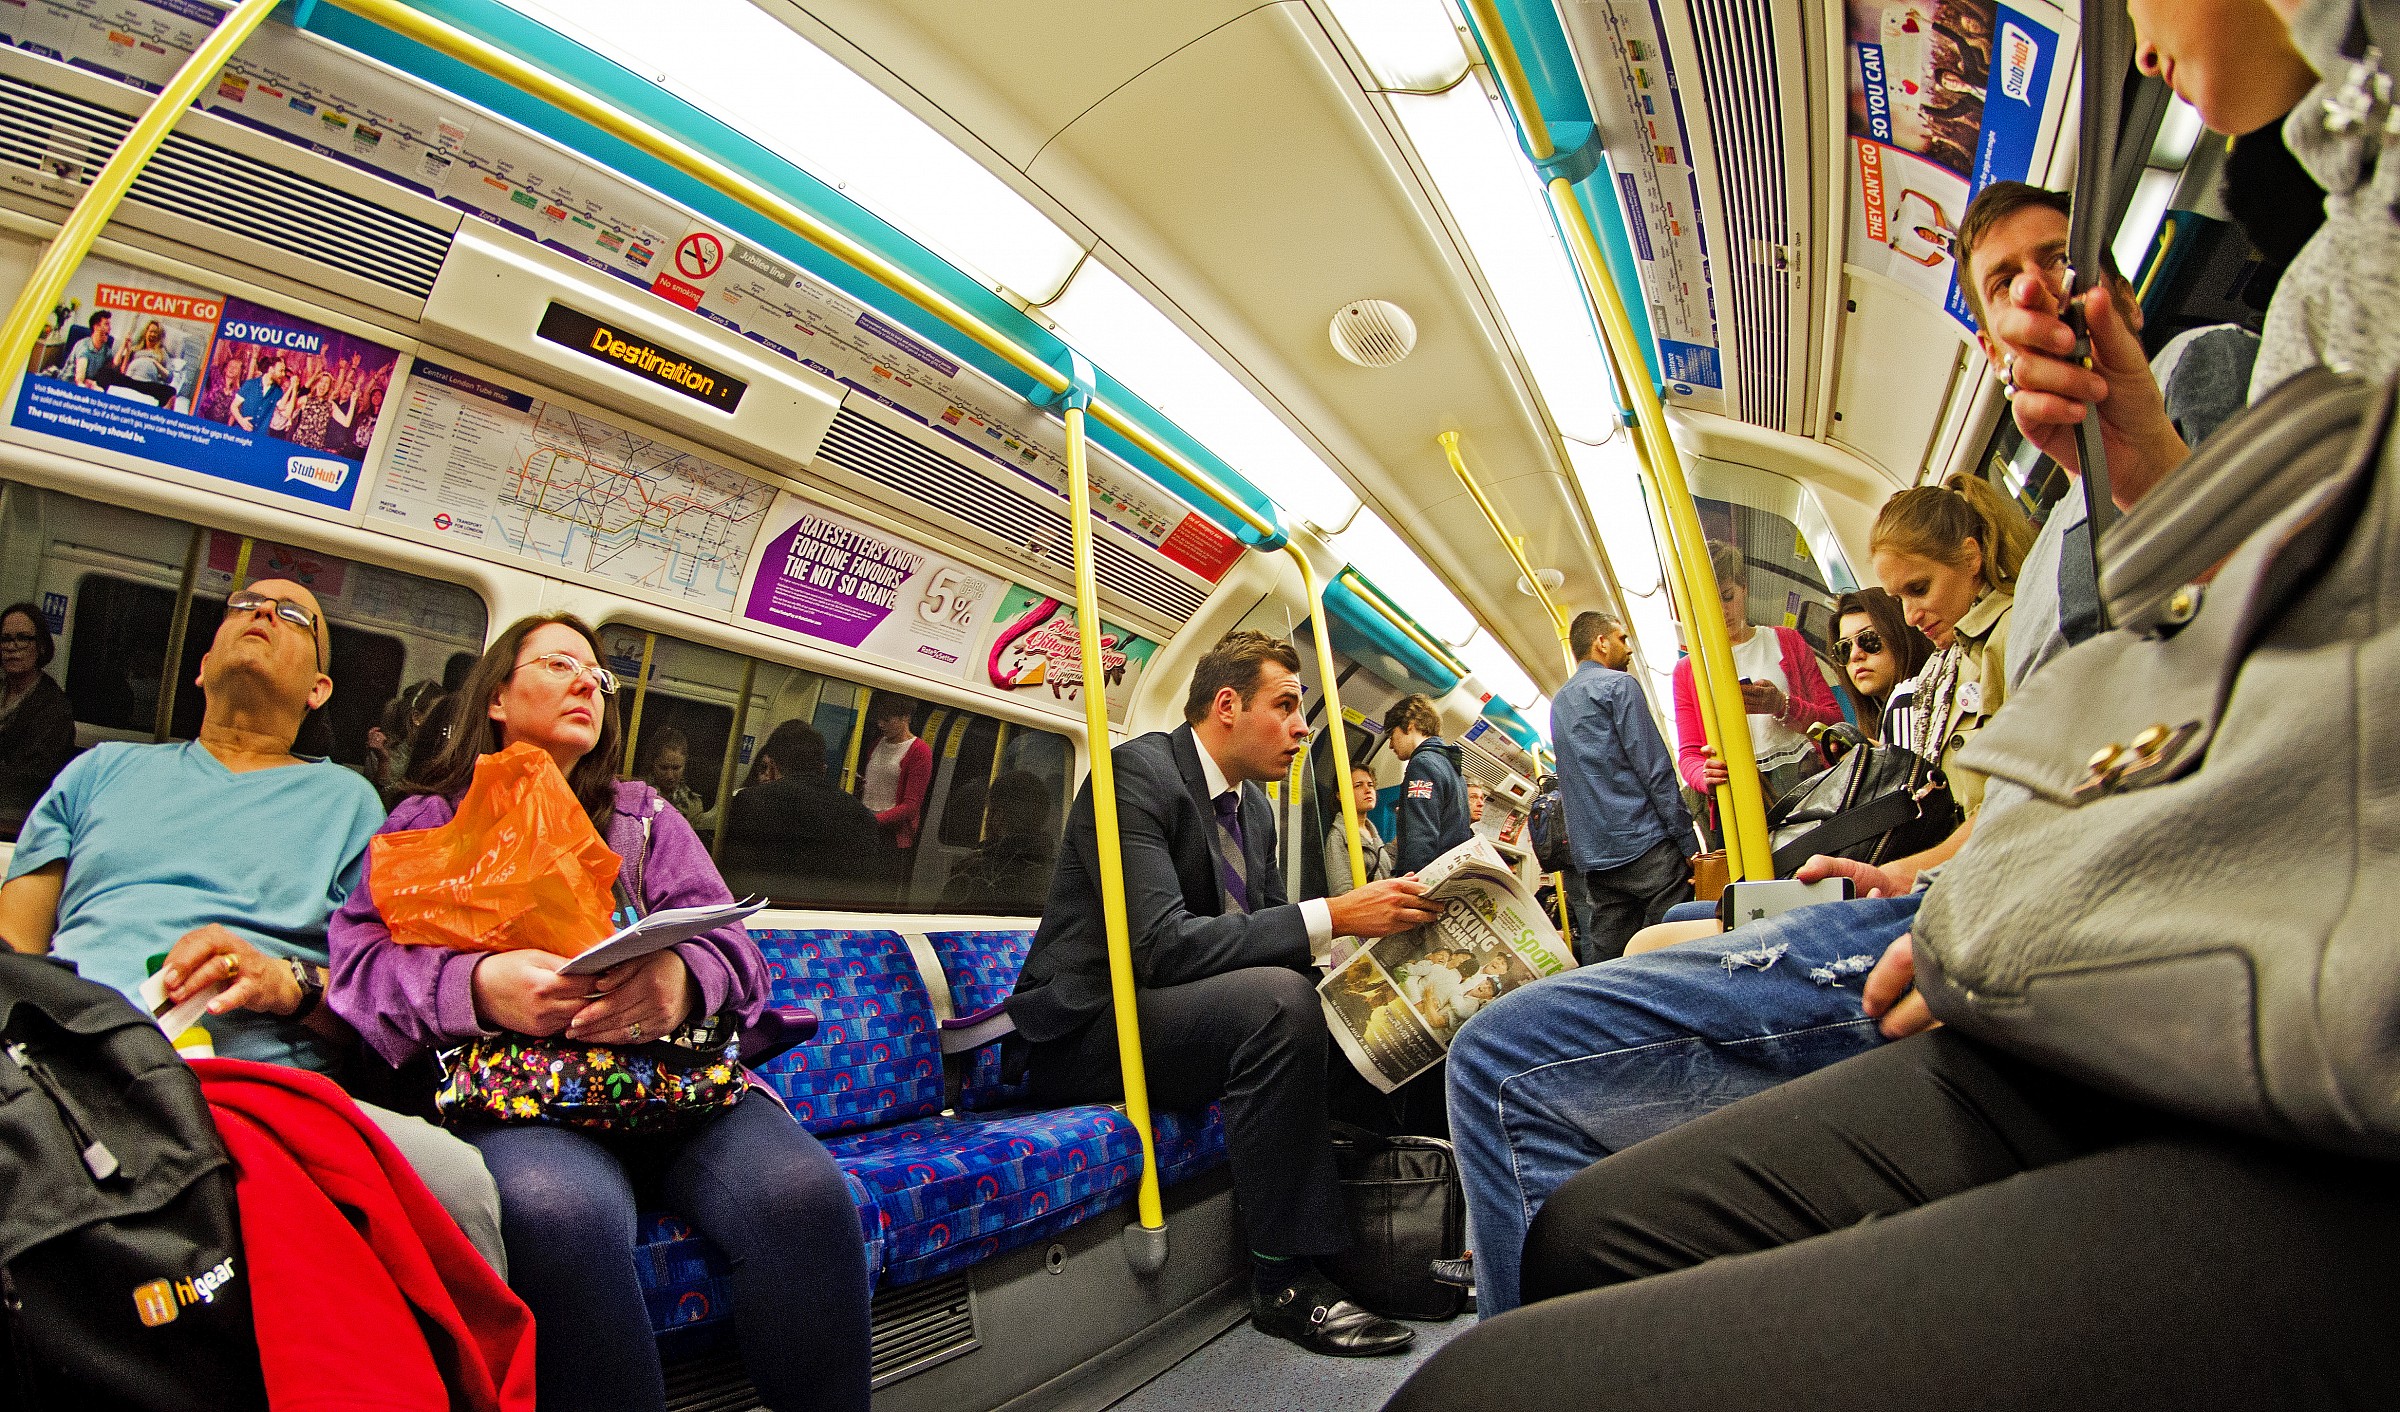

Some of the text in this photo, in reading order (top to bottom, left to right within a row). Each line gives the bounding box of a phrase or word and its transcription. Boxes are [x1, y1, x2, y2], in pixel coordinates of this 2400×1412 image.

[2007, 32, 2031, 95] StubHub!
[1863, 47, 1888, 139] SO YOU CAN
[1862, 143, 1883, 239] THEY CAN'T GO
[586, 256, 603, 270] Zone
[739, 251, 786, 280] Jubilee line
[101, 287, 218, 320] THEY CAN'T GO
[659, 277, 702, 301] No smoking
[708, 313, 725, 325] Zone
[224, 321, 319, 351] SO YOU CAN
[763, 338, 777, 350] Zone
[590, 327, 715, 396] Destination
[810, 361, 824, 373] Zone
[422, 367, 448, 380] Central
[448, 376, 475, 390] London
[476, 385, 493, 397] Tube
[28, 405, 146, 443] The way ticket buying should be.
[291, 460, 341, 486] StubHub!
[799, 514, 925, 575] RATESETTERS KNOW
[783, 555, 811, 580] THE
[809, 564, 840, 590] NOT
[838, 575, 857, 596] SO
[790, 534, 904, 589] FORTUNE FAVOURS
[964, 576, 987, 592] EARN
[1026, 630, 1074, 658] Glittery
[1057, 670, 1085, 683] pigeon
[1448, 900, 1500, 953] OKING
[1349, 1025, 1361, 1039] JULY
[1361, 1044, 1378, 1063] BOOK
